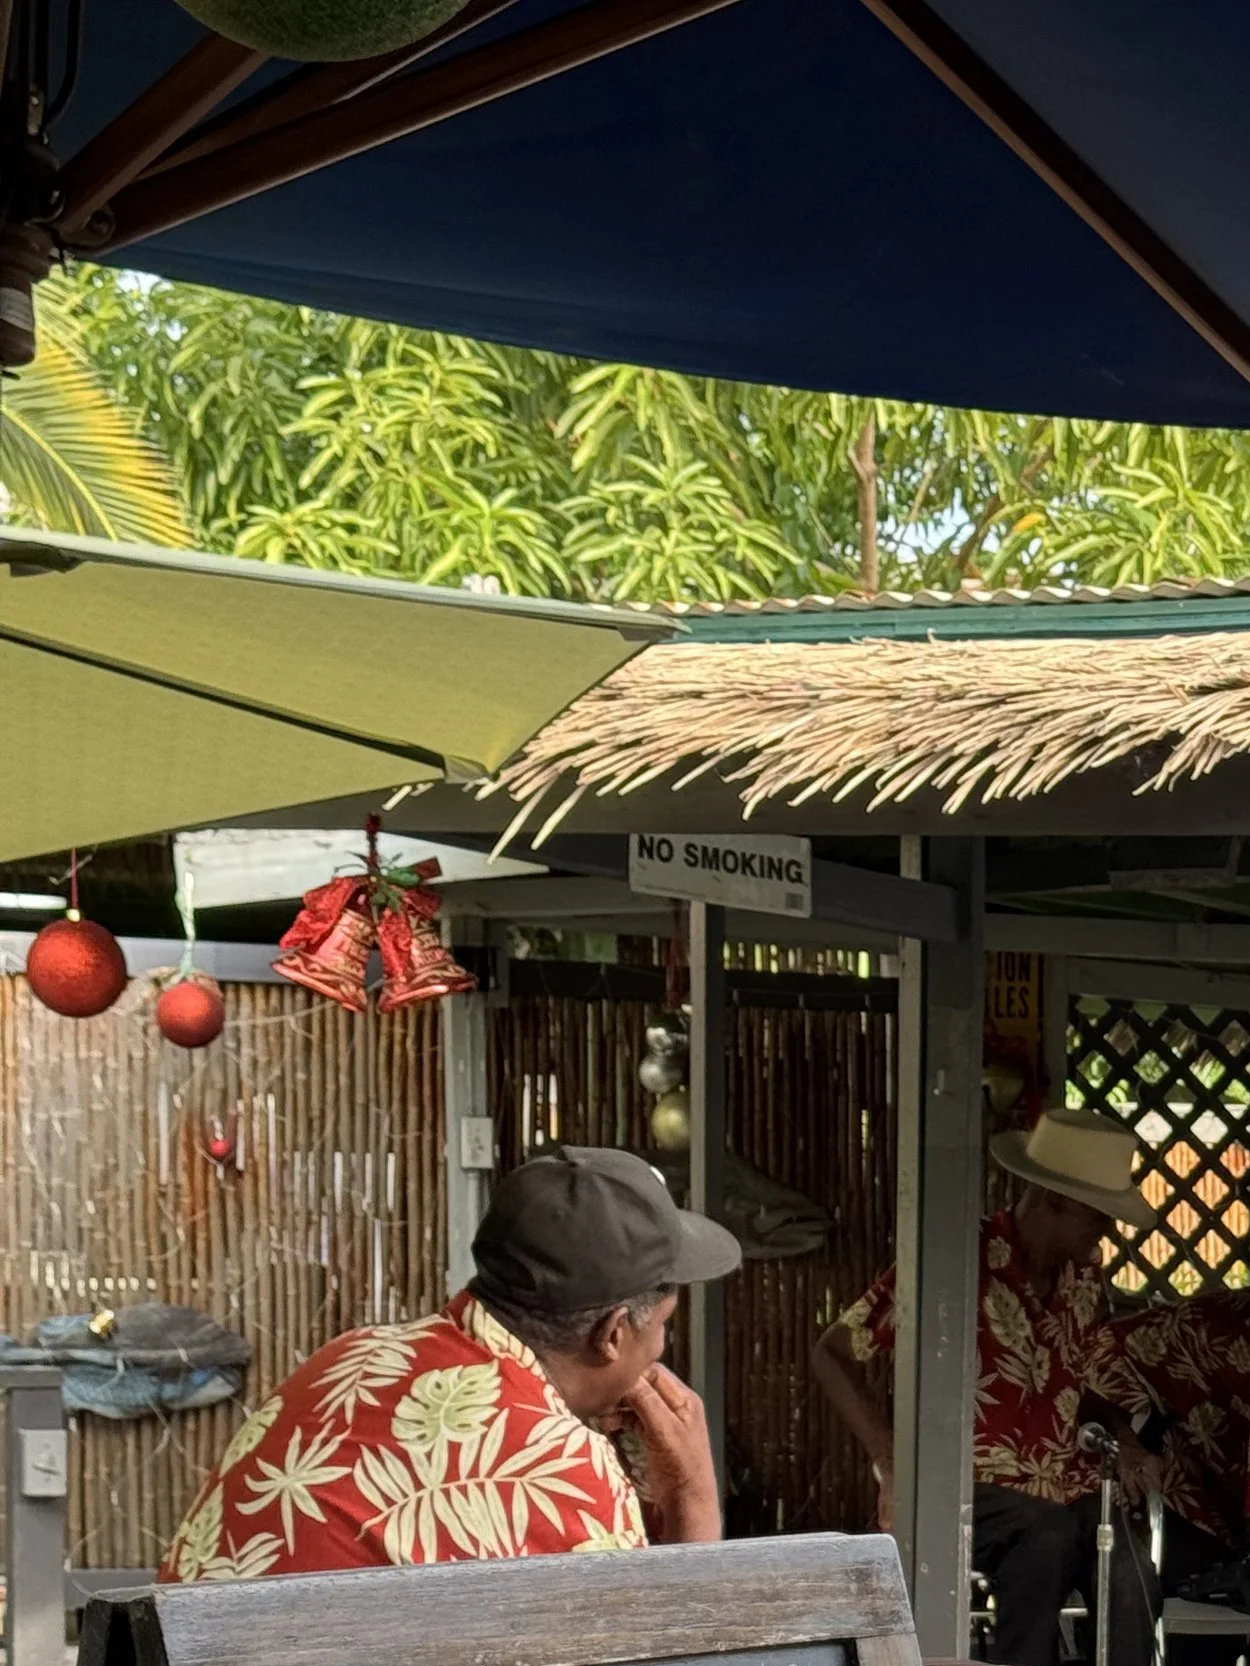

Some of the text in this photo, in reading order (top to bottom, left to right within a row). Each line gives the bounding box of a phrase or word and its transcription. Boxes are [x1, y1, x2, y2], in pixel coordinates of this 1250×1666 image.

[638, 834, 805, 884] NO SMOKING
[986, 952, 1031, 982] ION
